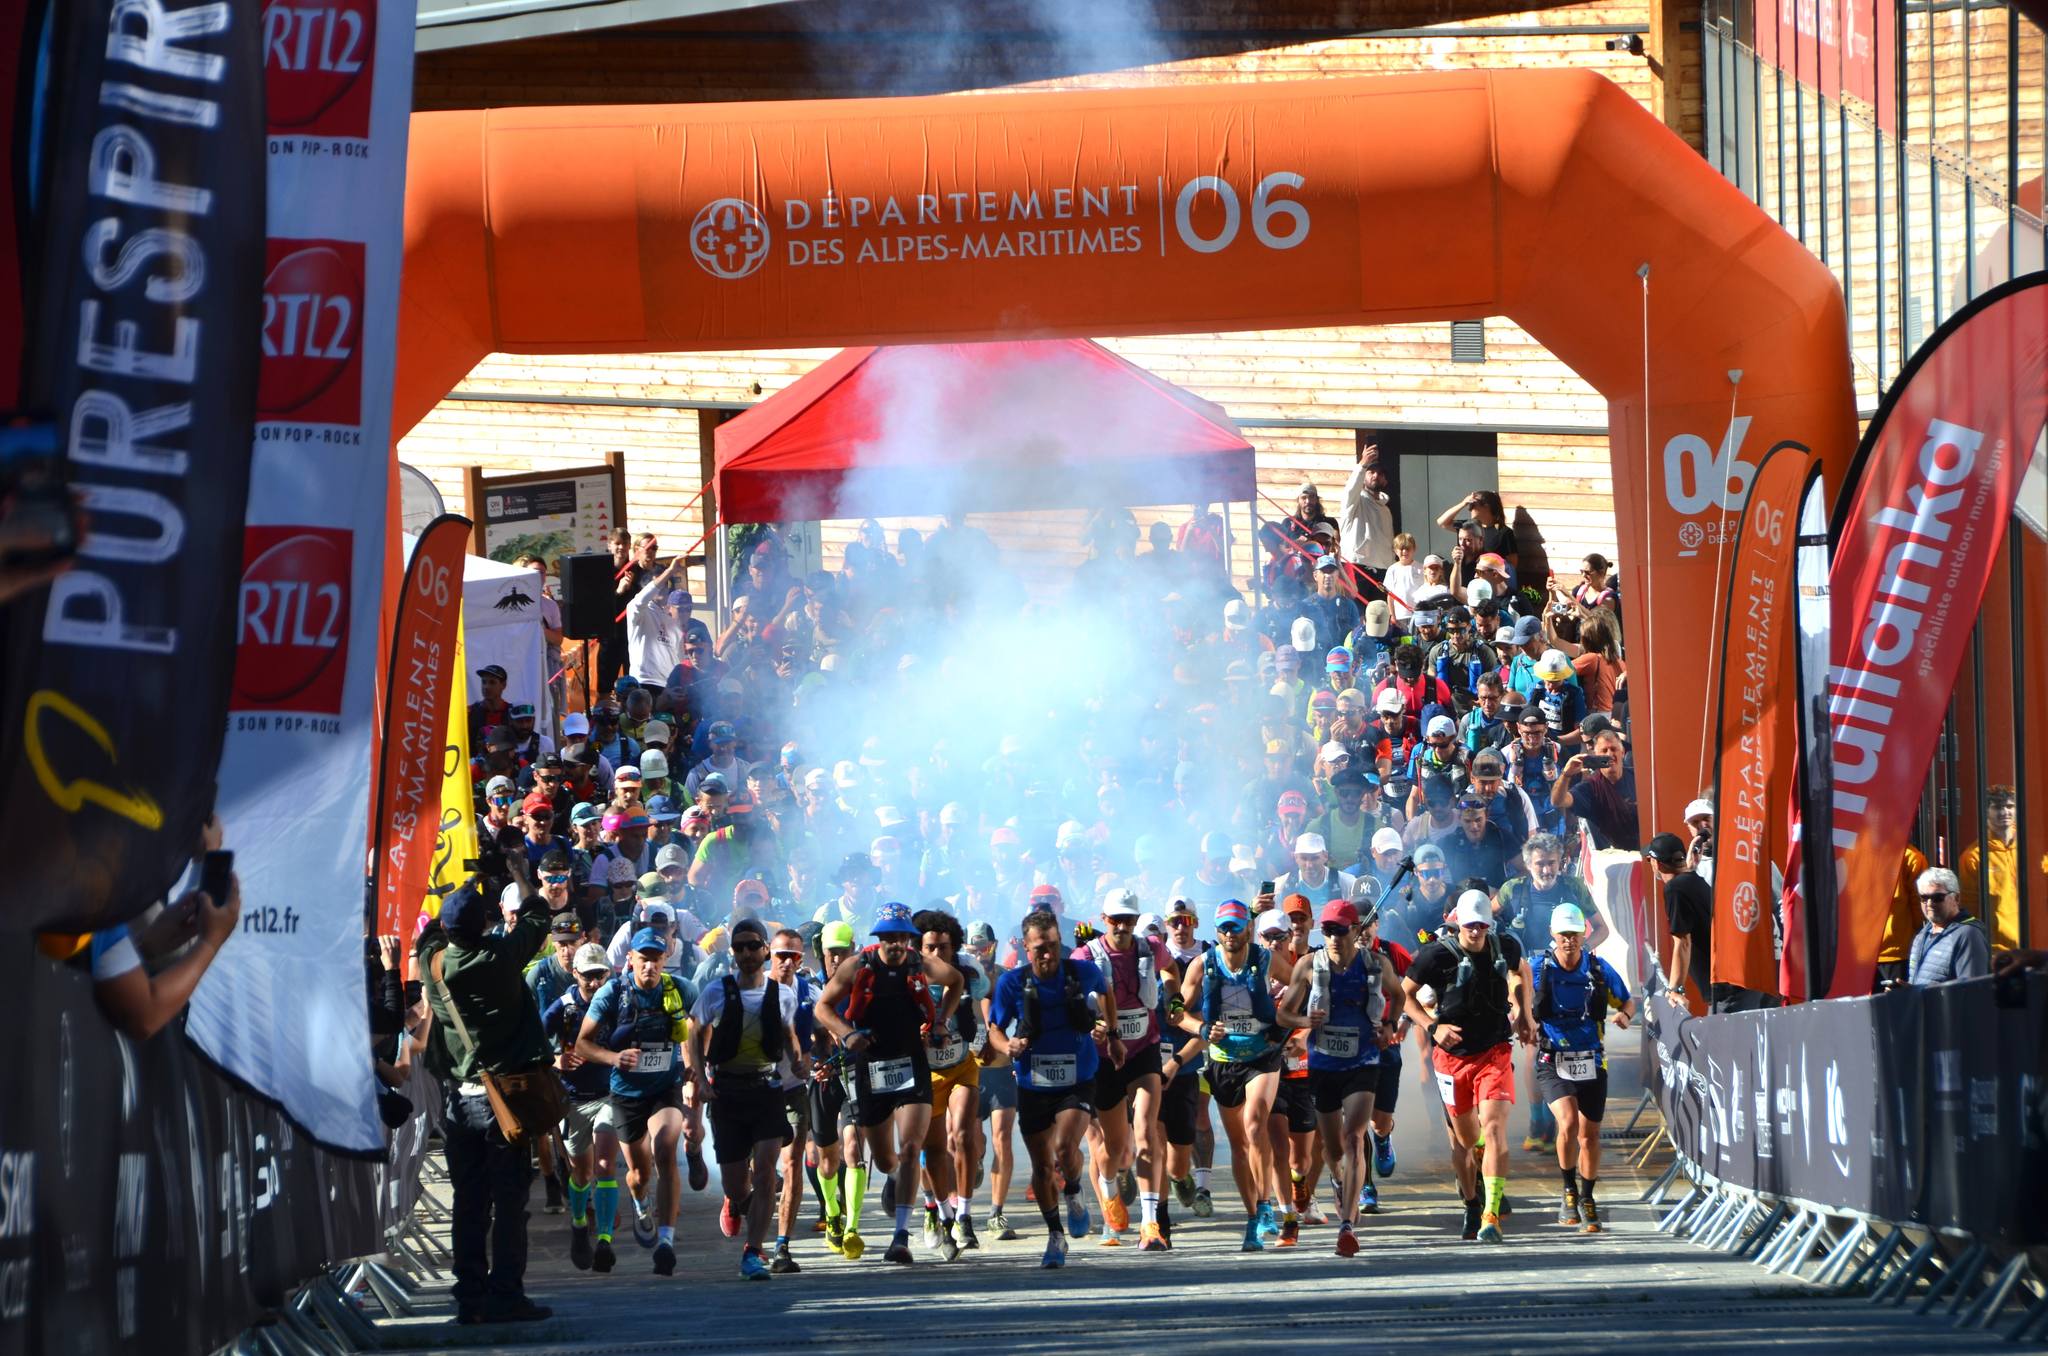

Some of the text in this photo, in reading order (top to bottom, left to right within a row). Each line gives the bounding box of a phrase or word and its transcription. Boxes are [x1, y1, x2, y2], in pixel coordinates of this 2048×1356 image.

[263, 7, 364, 74] RTL2
[269, 141, 293, 154] ON
[785, 171, 1311, 255] DÉPARTEMENT 06
[788, 225, 1143, 267] DES ALPES-MARITIMES
[284, 427, 361, 446] POP-ROCK
[1664, 416, 1752, 514] 06
[1755, 500, 1784, 546] 06
[1918, 438, 2006, 678] spécialiste outdoor montagne
[417, 554, 450, 608] 06
[237, 580, 342, 648] RTL2
[1798, 418, 1985, 898] ullanka
[1752, 577, 1775, 811] ALPARITIMES
[238, 717, 267, 731] SON
[275, 717, 341, 734] POP-ROCK
[1734, 570, 1763, 863] DÉPARTEMENT
[243, 905, 300, 934] rtl2.fr
[1122, 1022, 1142, 1034] 1100
[1232, 1022, 1253, 1034] 1263
[935, 1049, 955, 1061] 1286
[1327, 1039, 1349, 1052] 1206
[644, 1055, 662, 1066] 1231
[1046, 1067, 1065, 1080] 1013
[1568, 1063, 1587, 1075] 1223
[883, 1071, 905, 1086] 1010
